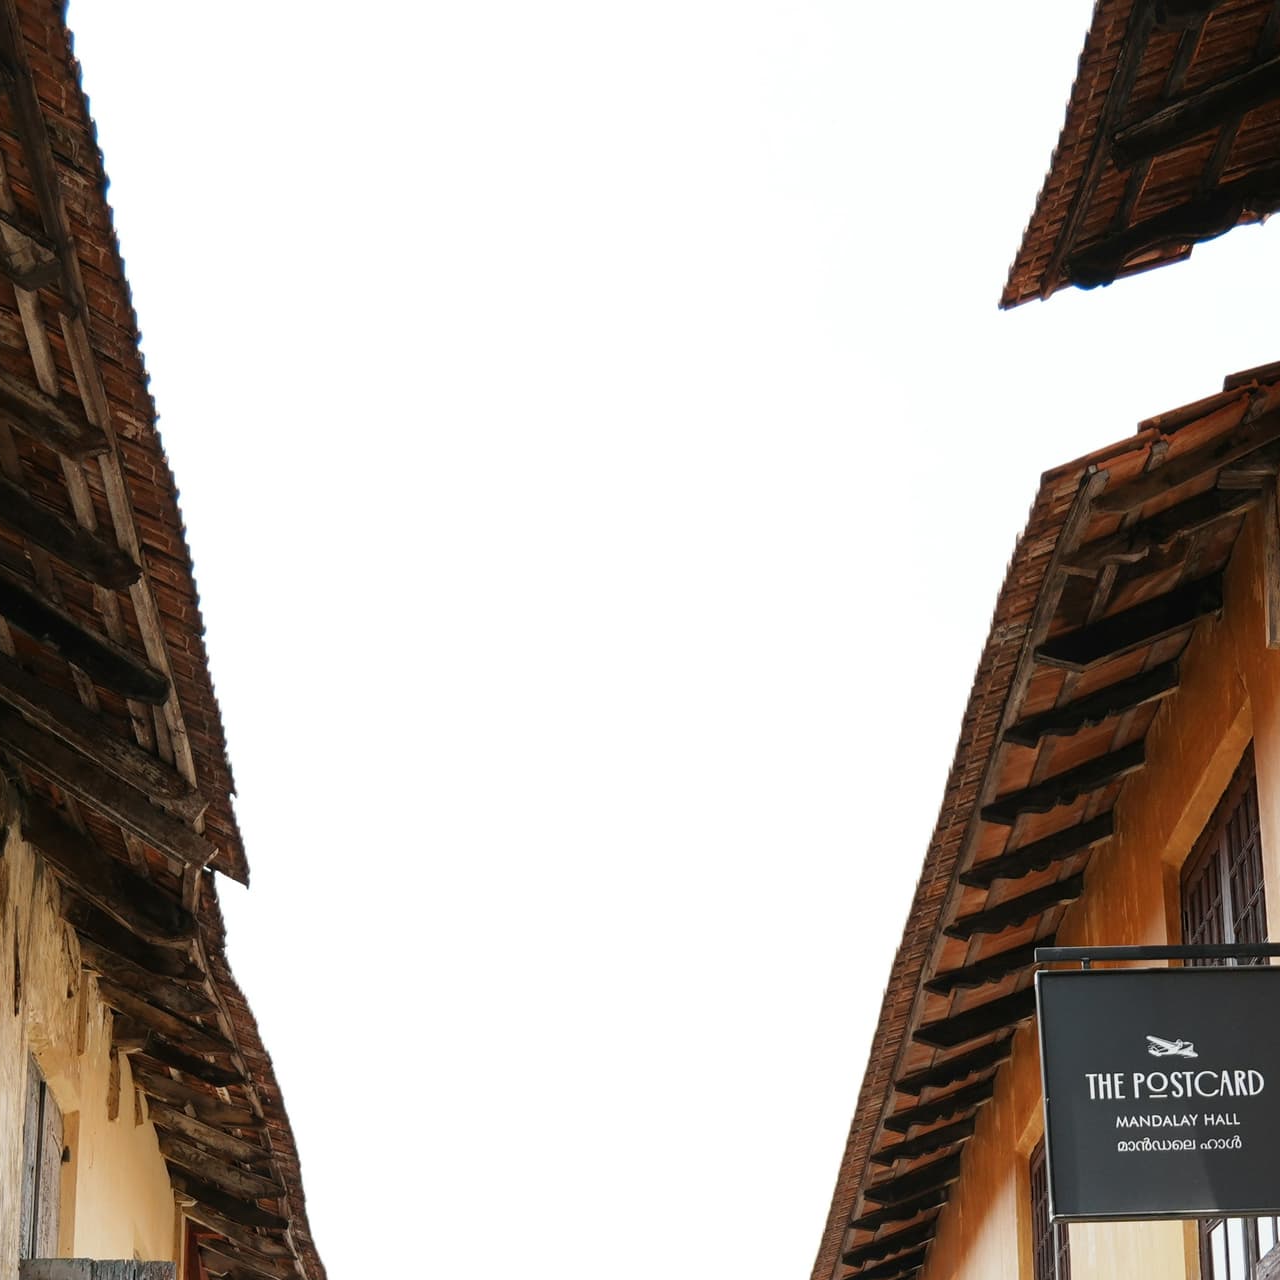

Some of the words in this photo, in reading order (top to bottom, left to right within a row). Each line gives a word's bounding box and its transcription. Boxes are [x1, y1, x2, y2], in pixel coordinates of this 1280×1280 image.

[1085, 1073, 1126, 1100] THE
[1133, 1070, 1265, 1099] POSTCARD
[1116, 1114, 1198, 1129] MANDALAY
[1204, 1113, 1241, 1126] HALL
